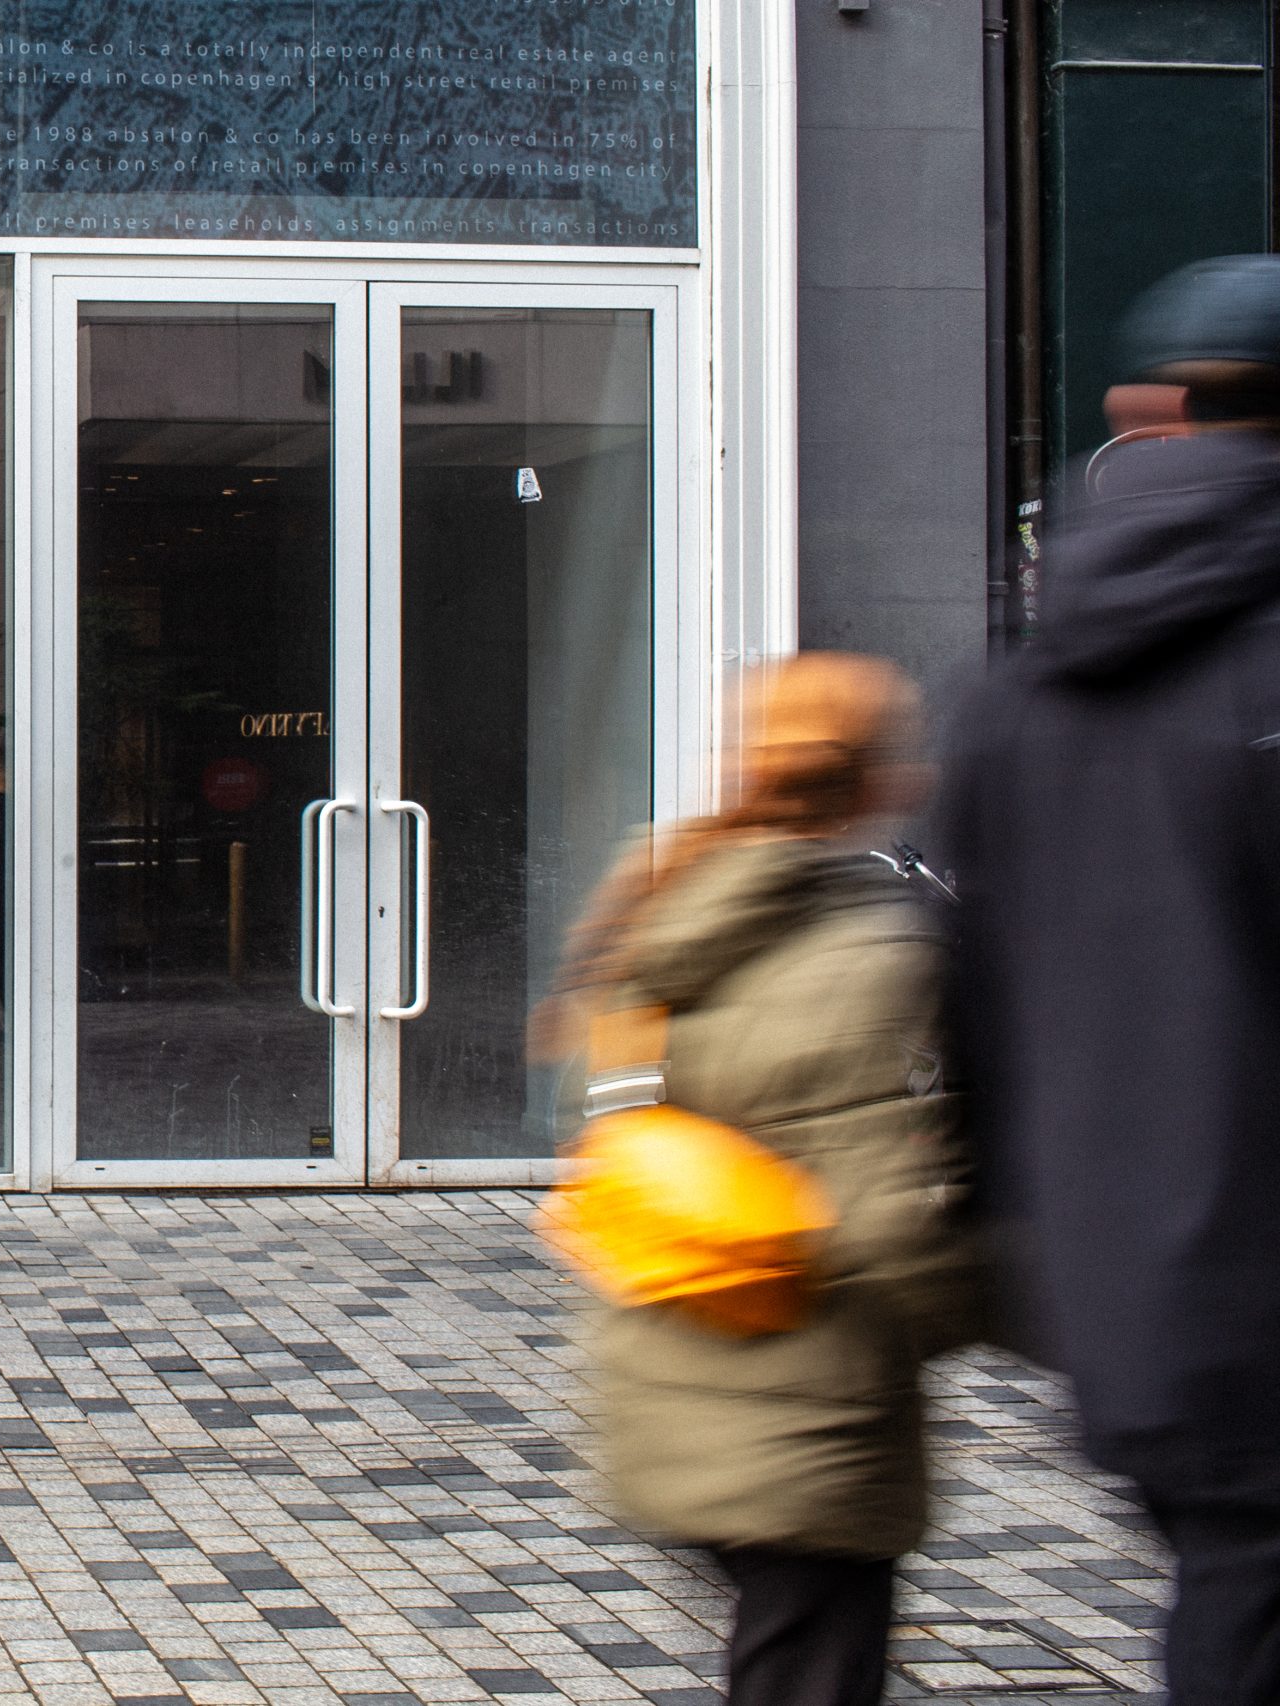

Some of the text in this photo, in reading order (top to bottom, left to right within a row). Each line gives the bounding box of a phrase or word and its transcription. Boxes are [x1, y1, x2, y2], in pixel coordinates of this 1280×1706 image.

[61, 40, 75, 55] &
[89, 43, 114, 56] co
[129, 40, 146, 56] is
[160, 43, 170, 56] a
[185, 41, 270, 60] totally
[283, 41, 444, 63] independent
[458, 45, 504, 60] real
[518, 46, 593, 62] estate
[607, 48, 677, 66] agent
[106, 69, 127, 84] in
[338, 72, 391, 91] high
[404, 74, 478, 89] street
[490, 74, 556, 91] retail
[570, 76, 678, 95] premises
[34, 127, 92, 142] 1988
[108, 127, 210, 143] absalon
[225, 129, 238, 143] &
[253, 131, 279, 145] co
[295, 129, 336, 145] has
[351, 129, 411, 146] been
[426, 131, 537, 148] involved
[552, 132, 575, 148] in
[589, 133, 638, 149] 75%
[653, 133, 677, 149] of
[174, 156, 198, 172] of
[212, 157, 281, 174] retail
[296, 160, 409, 179] premises
[423, 159, 445, 175] in
[459, 160, 611, 181] copenhagen
[626, 162, 672, 182] city
[36, 215, 151, 233] premises
[175, 214, 313, 233] leaseholds
[336, 217, 495, 237] assignments
[519, 218, 678, 236] transactions
